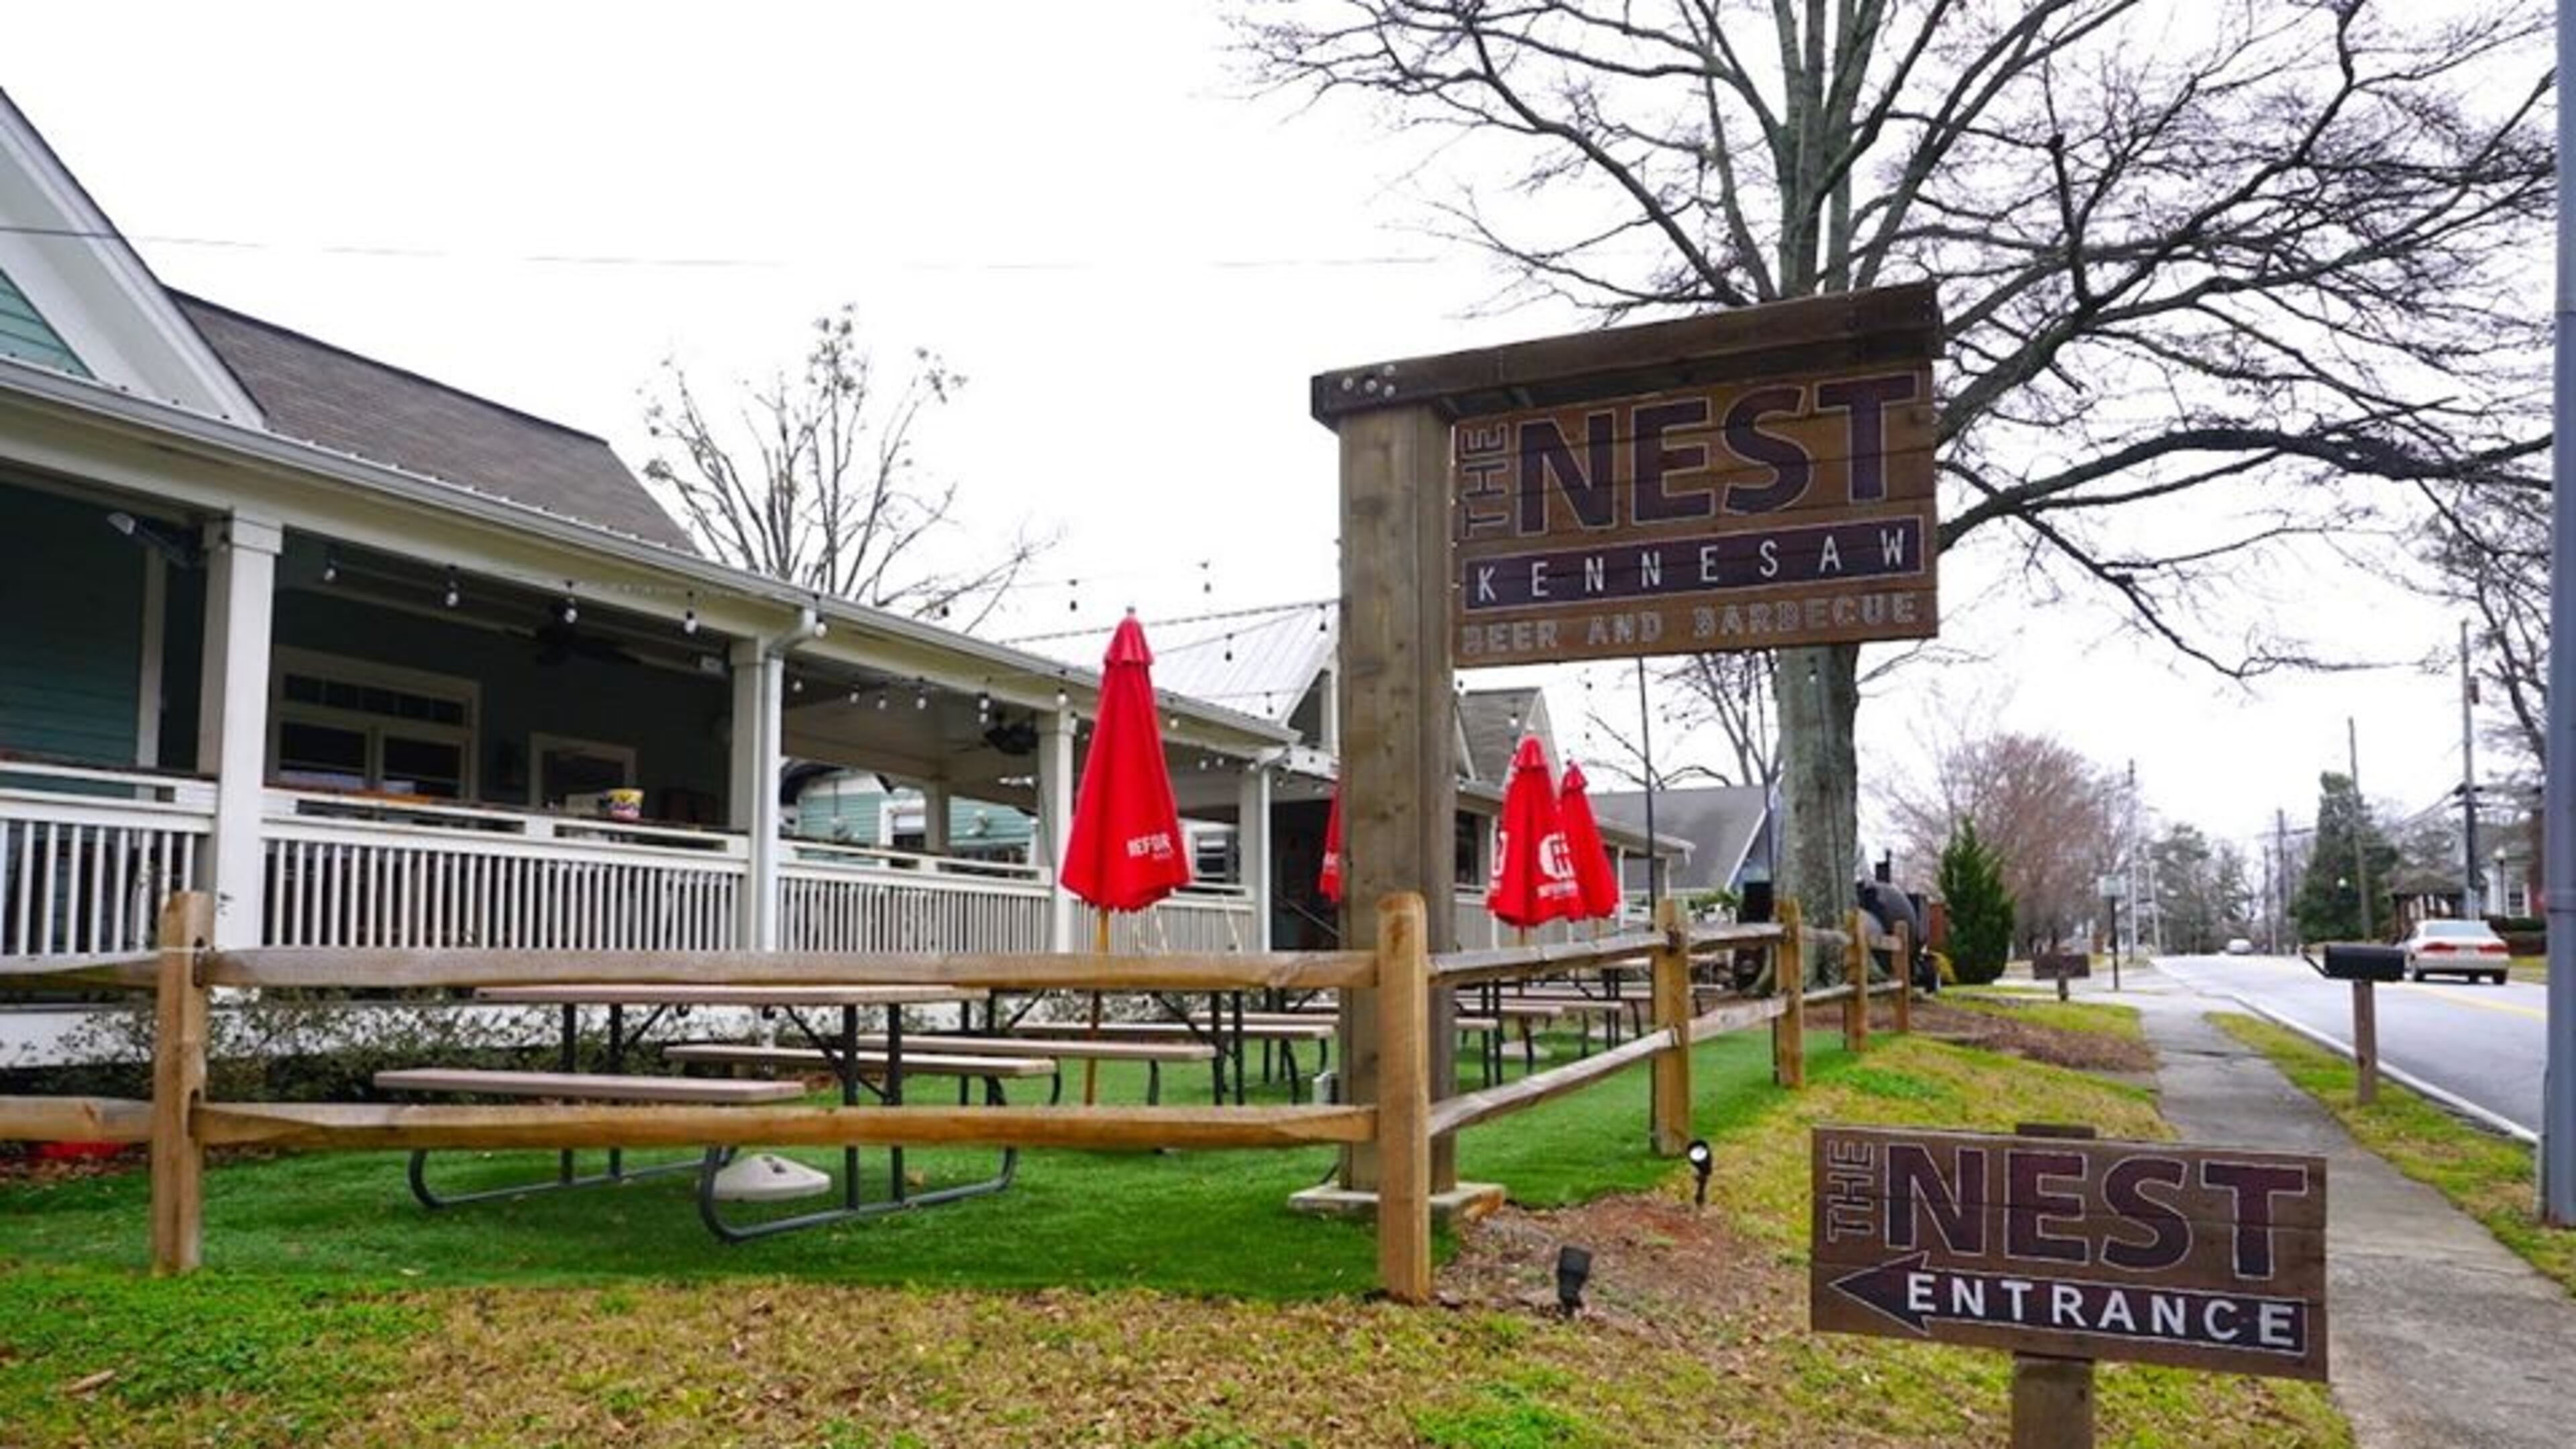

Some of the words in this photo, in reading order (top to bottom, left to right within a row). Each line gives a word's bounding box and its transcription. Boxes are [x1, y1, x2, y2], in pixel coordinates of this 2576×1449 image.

[1460, 423, 1509, 538] THE
[1517, 370, 1919, 535] NEST
[1478, 528, 1905, 602] KENNESAW
[1462, 619, 1558, 655] BEER
[1587, 611, 1661, 645] AND
[1693, 592, 1917, 637] BARBECUE
[1827, 1138, 1874, 1243] THE
[1885, 1142, 2308, 1281] NEST
[1907, 1272, 2296, 1346] ENTRANCE
